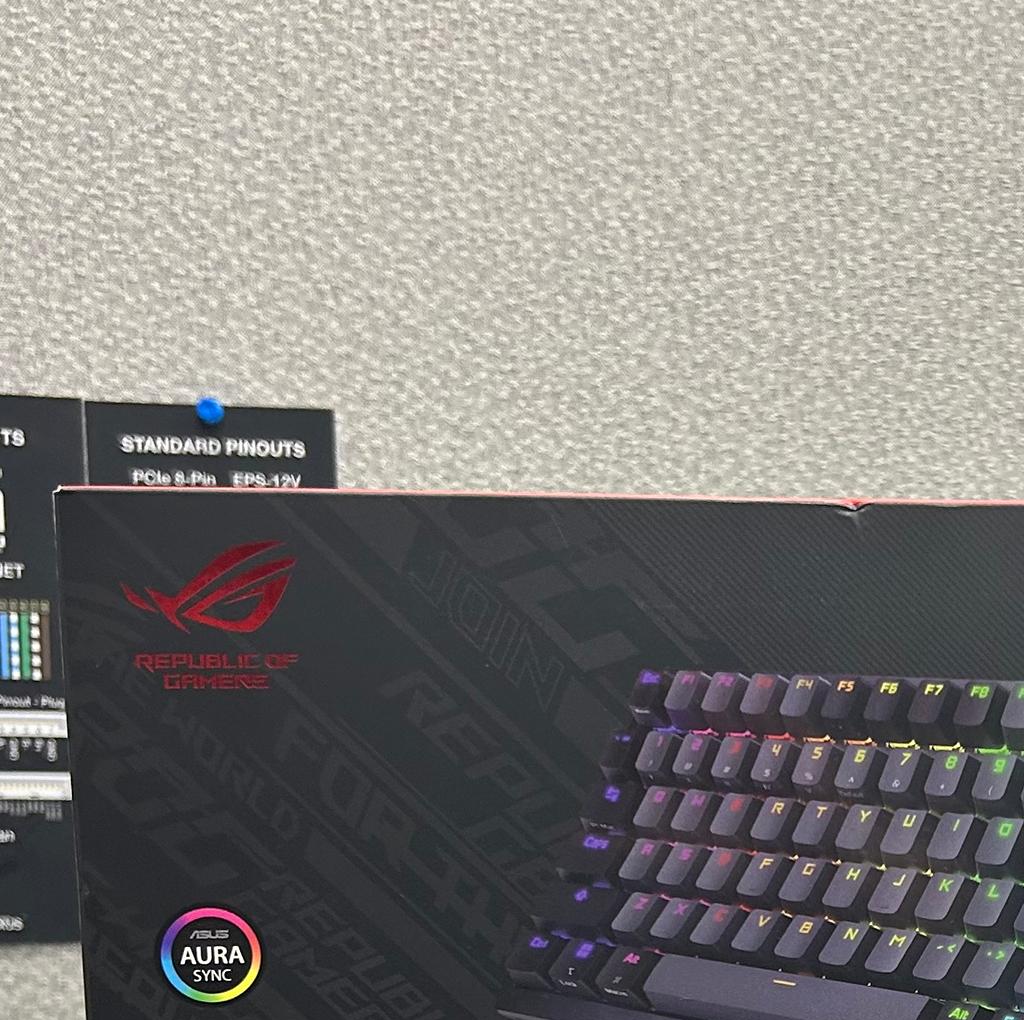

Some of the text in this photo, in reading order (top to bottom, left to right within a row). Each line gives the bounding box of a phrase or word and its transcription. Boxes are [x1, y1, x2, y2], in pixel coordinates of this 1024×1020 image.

[120, 434, 307, 460] STANDARD PINOUTS
[134, 653, 300, 672] REPUBLIC OF
[796, 678, 813, 689] F4
[837, 680, 855, 692] F5
[880, 682, 898, 694] F6
[925, 684, 944, 696] F7
[970, 685, 990, 698] F8
[772, 743, 783, 757] 4
[811, 746, 823, 760] 5
[854, 750, 866, 763] 6
[900, 753, 911, 766] 7
[945, 755, 959, 769] 8
[771, 802, 785, 814] R
[816, 806, 828, 818] T
[860, 810, 872, 823] Y
[903, 814, 917, 828] U
[759, 858, 774, 870] F
[802, 864, 816, 876] G
[847, 868, 861, 881] H
[893, 873, 907, 886] J
[939, 879, 954, 892] K
[986, 885, 1000, 898] L
[189, 929, 230, 940] ASUS
[758, 915, 771, 928] V
[799, 921, 813, 934] B
[843, 927, 859, 940] N
[889, 934, 906, 947] M
[180, 945, 245, 966] AURA
[192, 969, 233, 983] SYNC
[948, 1007, 970, 1020] Alt
